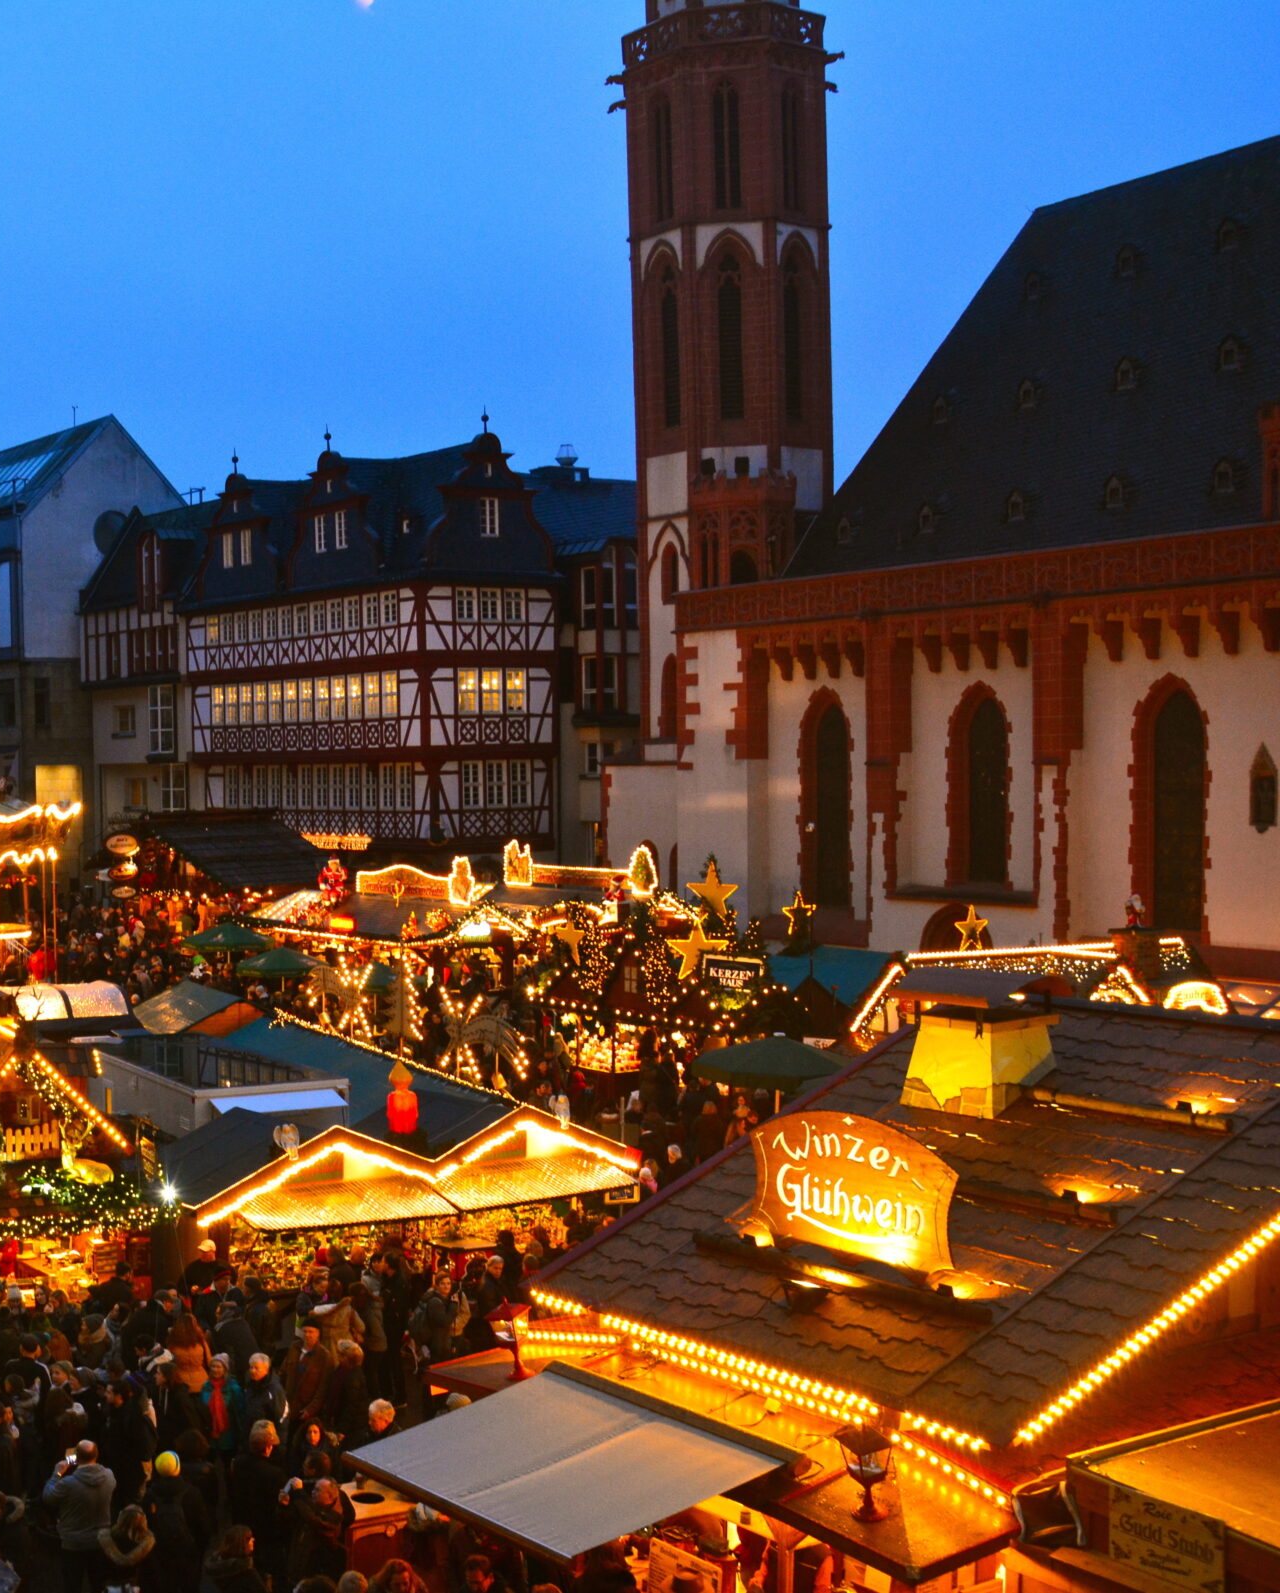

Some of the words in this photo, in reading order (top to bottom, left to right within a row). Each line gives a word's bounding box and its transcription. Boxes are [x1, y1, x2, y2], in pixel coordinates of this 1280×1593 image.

[709, 967, 755, 981] KERZEN
[719, 978, 744, 988] HAUS
[776, 1163, 926, 1238] Glühwein
[1120, 1513, 1163, 1543] Gudd
